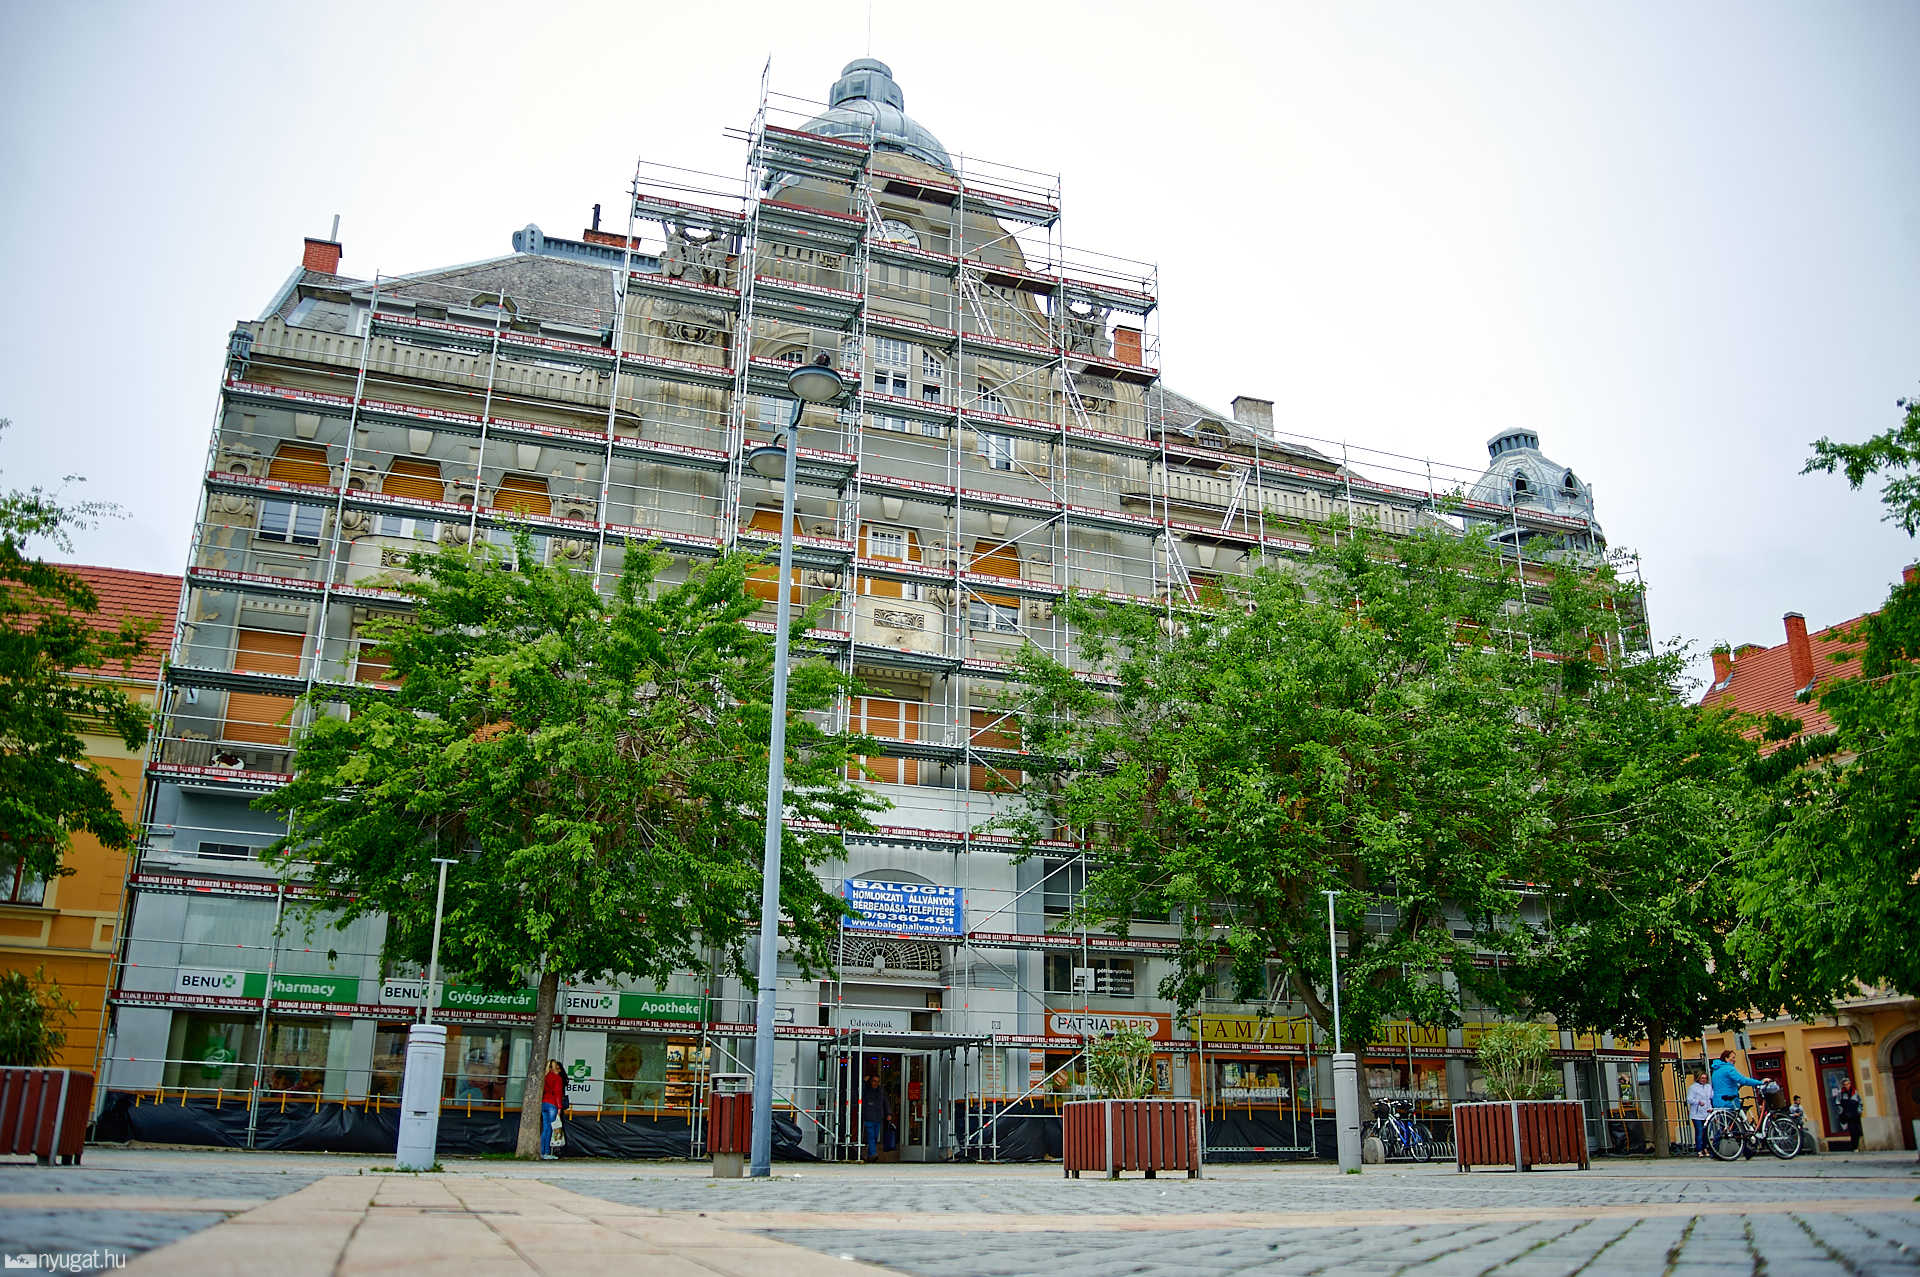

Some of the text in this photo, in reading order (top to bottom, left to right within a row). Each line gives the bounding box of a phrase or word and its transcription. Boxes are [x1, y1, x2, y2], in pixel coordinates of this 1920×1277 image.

[852, 880, 955, 895] BALOGH
[852, 890, 955, 906] HOMLOKZATI ÁLLVÁNYOK
[852, 900, 955, 917] BÉRBEADÁSA-TELEPÍTÉSE
[861, 911, 954, 925] 0/9360-451
[851, 919, 954, 933] www.baloghallvany.hu
[182, 975, 221, 988] BENU
[271, 978, 336, 997] Pharmacy
[384, 986, 420, 999] BENU
[448, 990, 532, 1005] Gyógyszertár
[567, 997, 599, 1009] BENU
[640, 1001, 699, 1015] Apotheke
[1200, 1020, 1299, 1040] FAMILY
[566, 1084, 591, 1092] BENU
[1221, 1087, 1290, 1098] ISKOLASZEREK
